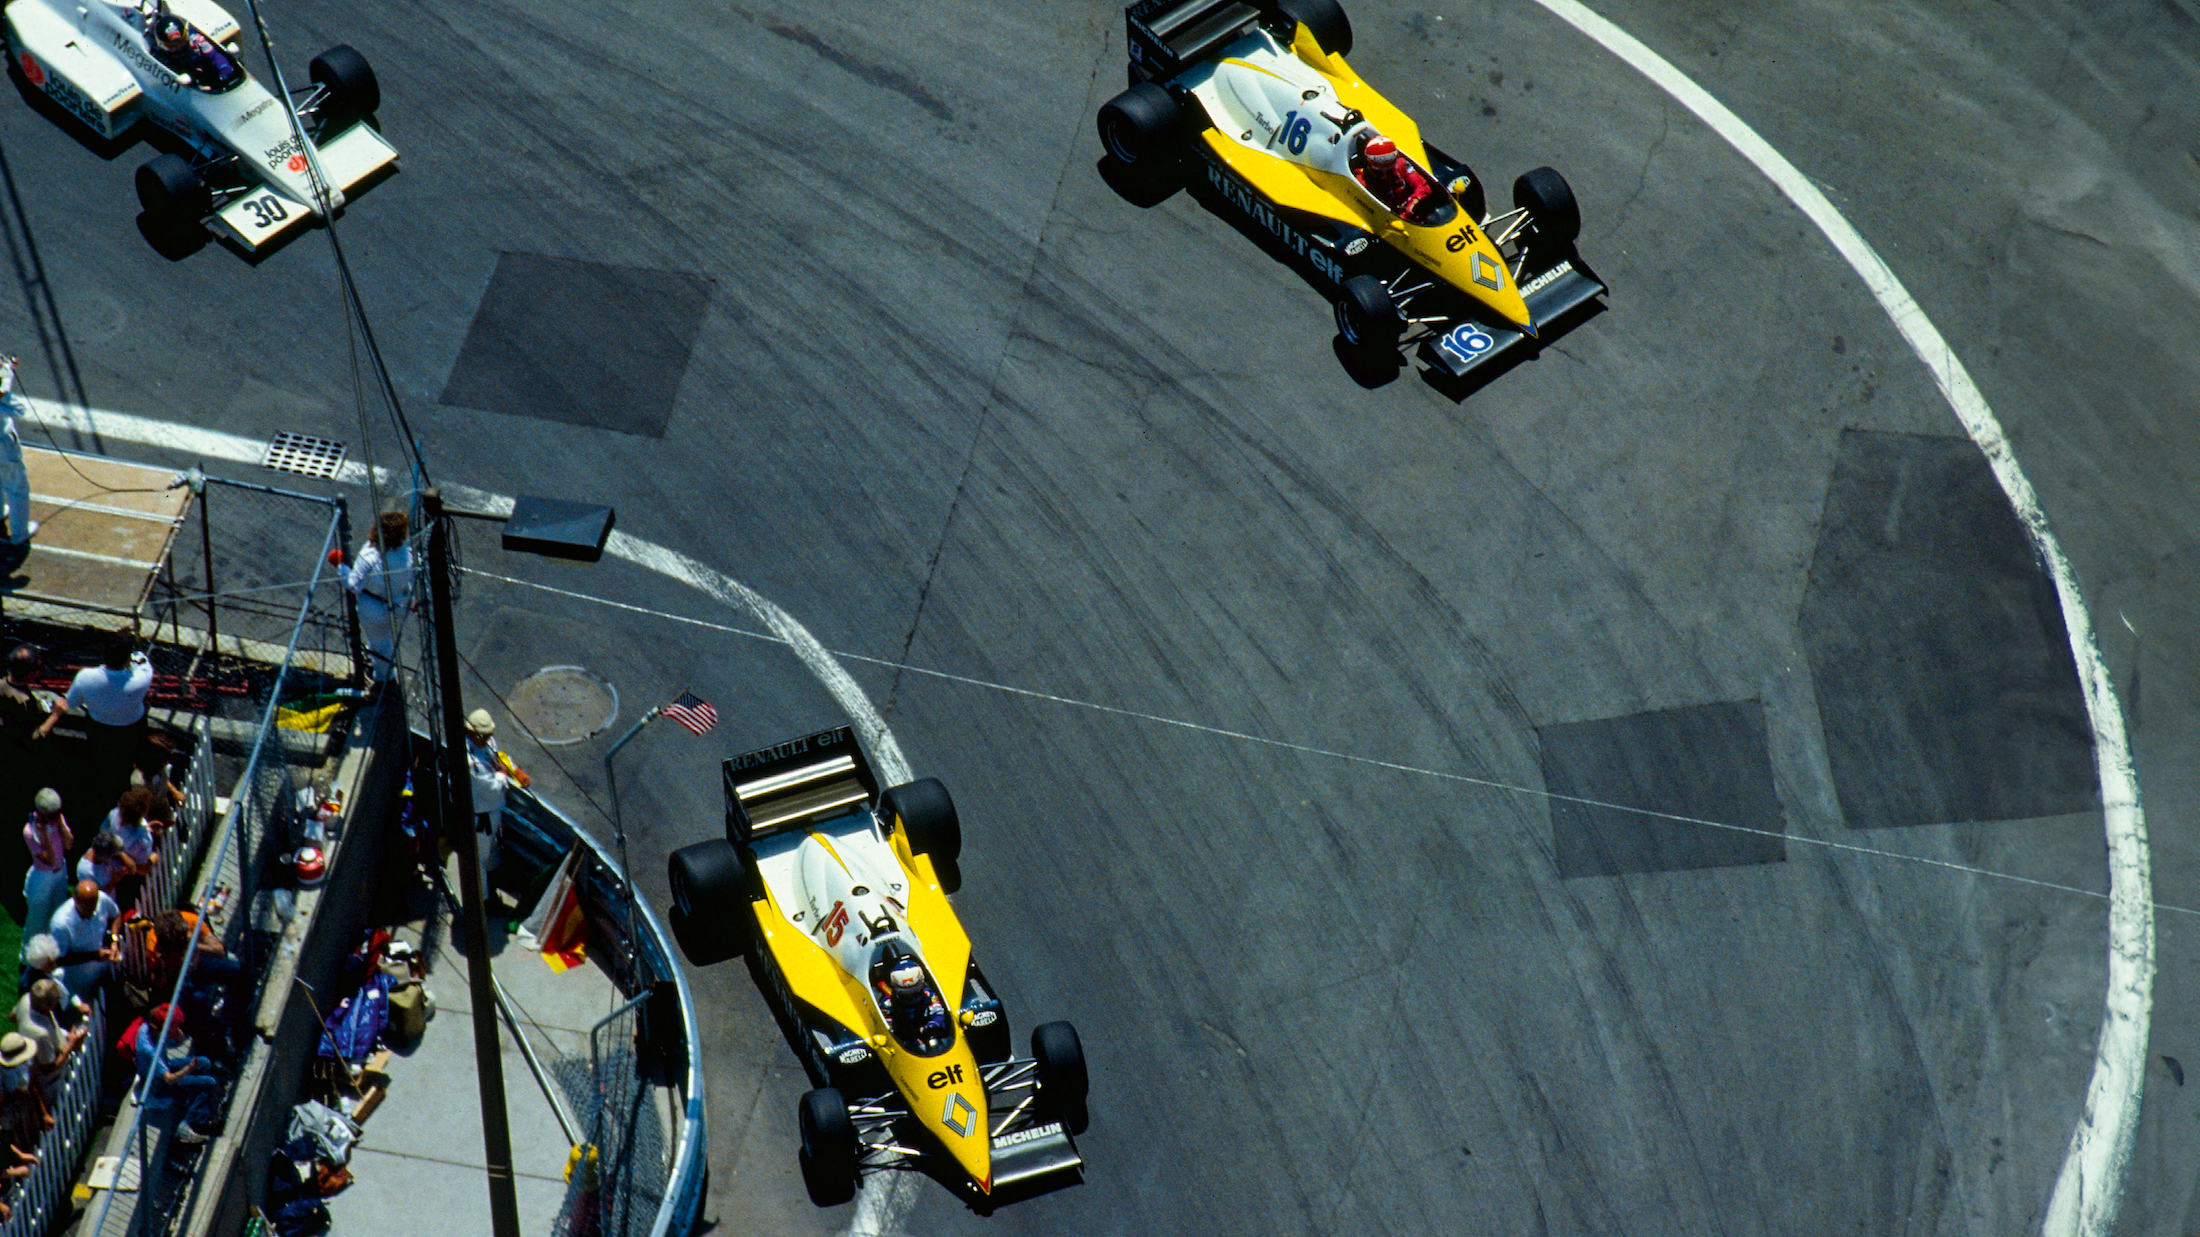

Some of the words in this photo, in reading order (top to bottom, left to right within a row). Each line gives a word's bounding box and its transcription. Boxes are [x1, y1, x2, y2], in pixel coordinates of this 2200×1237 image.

[113, 33, 181, 93] Megatron
[1255, 111, 1275, 135] Turbo
[1278, 110, 1312, 155] 16
[264, 141, 291, 159] louis
[243, 195, 288, 228] 30
[1207, 165, 1309, 257] RENAULT
[1309, 248, 1344, 285] elf
[1445, 224, 1479, 253] elf
[1519, 260, 1573, 299] MICHELIN
[1440, 322, 1494, 364] 16
[731, 739, 811, 772] RENAULT
[817, 729, 845, 747] elf
[821, 900, 850, 948] 15
[927, 1063, 964, 1090] elf
[993, 1122, 1063, 1149] MICHELIN
